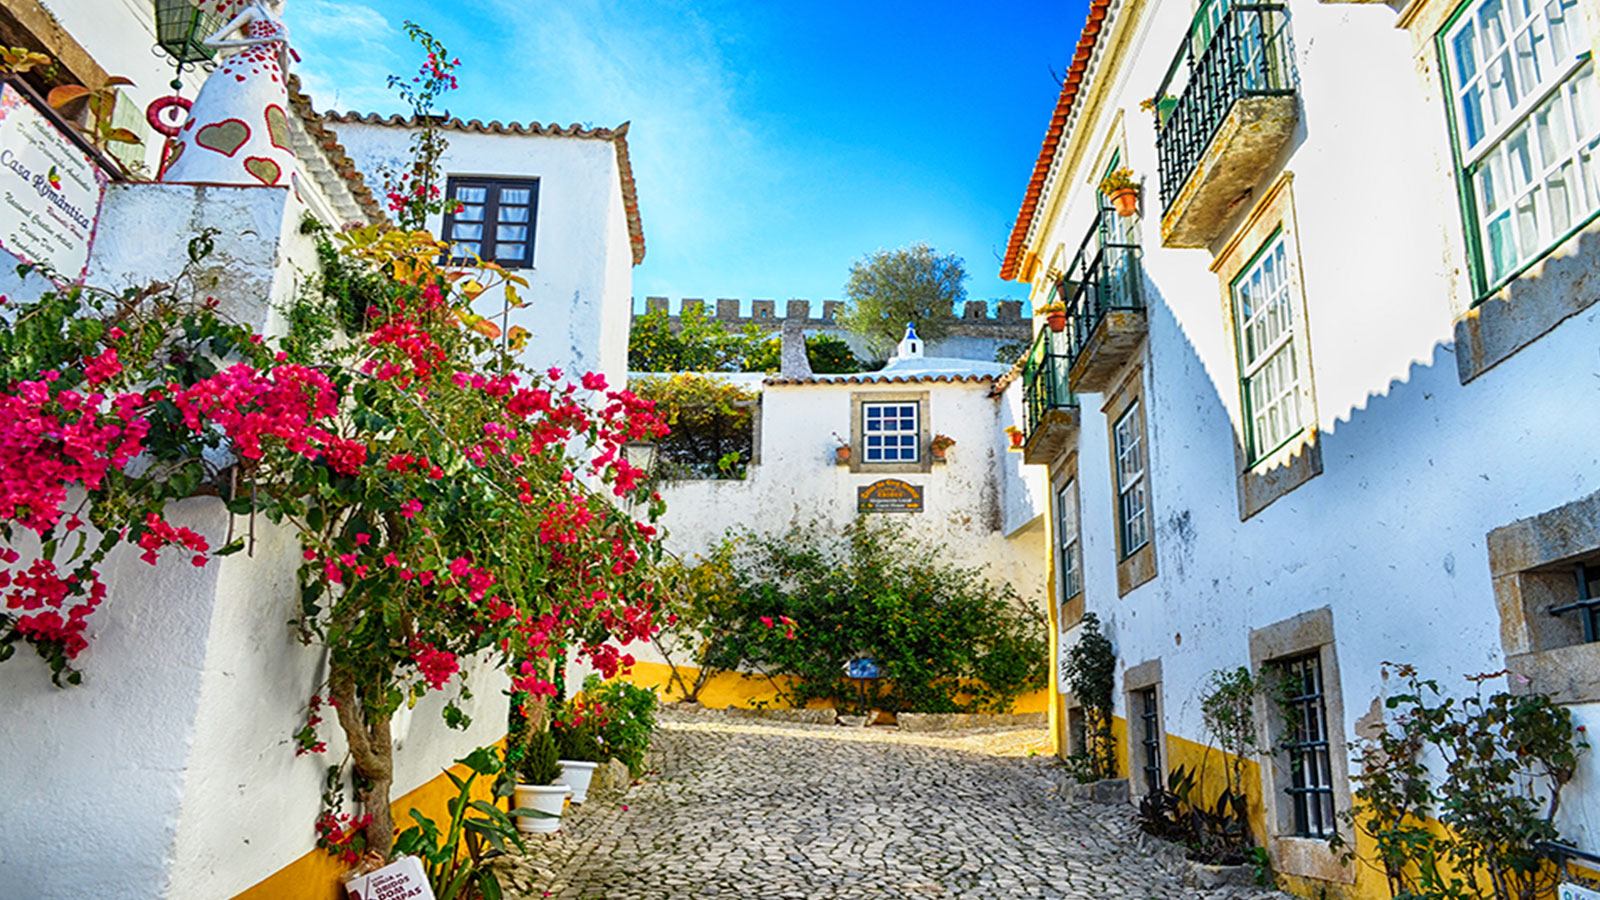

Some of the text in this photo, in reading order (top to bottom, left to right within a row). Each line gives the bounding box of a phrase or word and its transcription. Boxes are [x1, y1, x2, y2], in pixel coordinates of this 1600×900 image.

[0, 149, 90, 230] Casa Romântica
[378, 886, 405, 900] DOM
